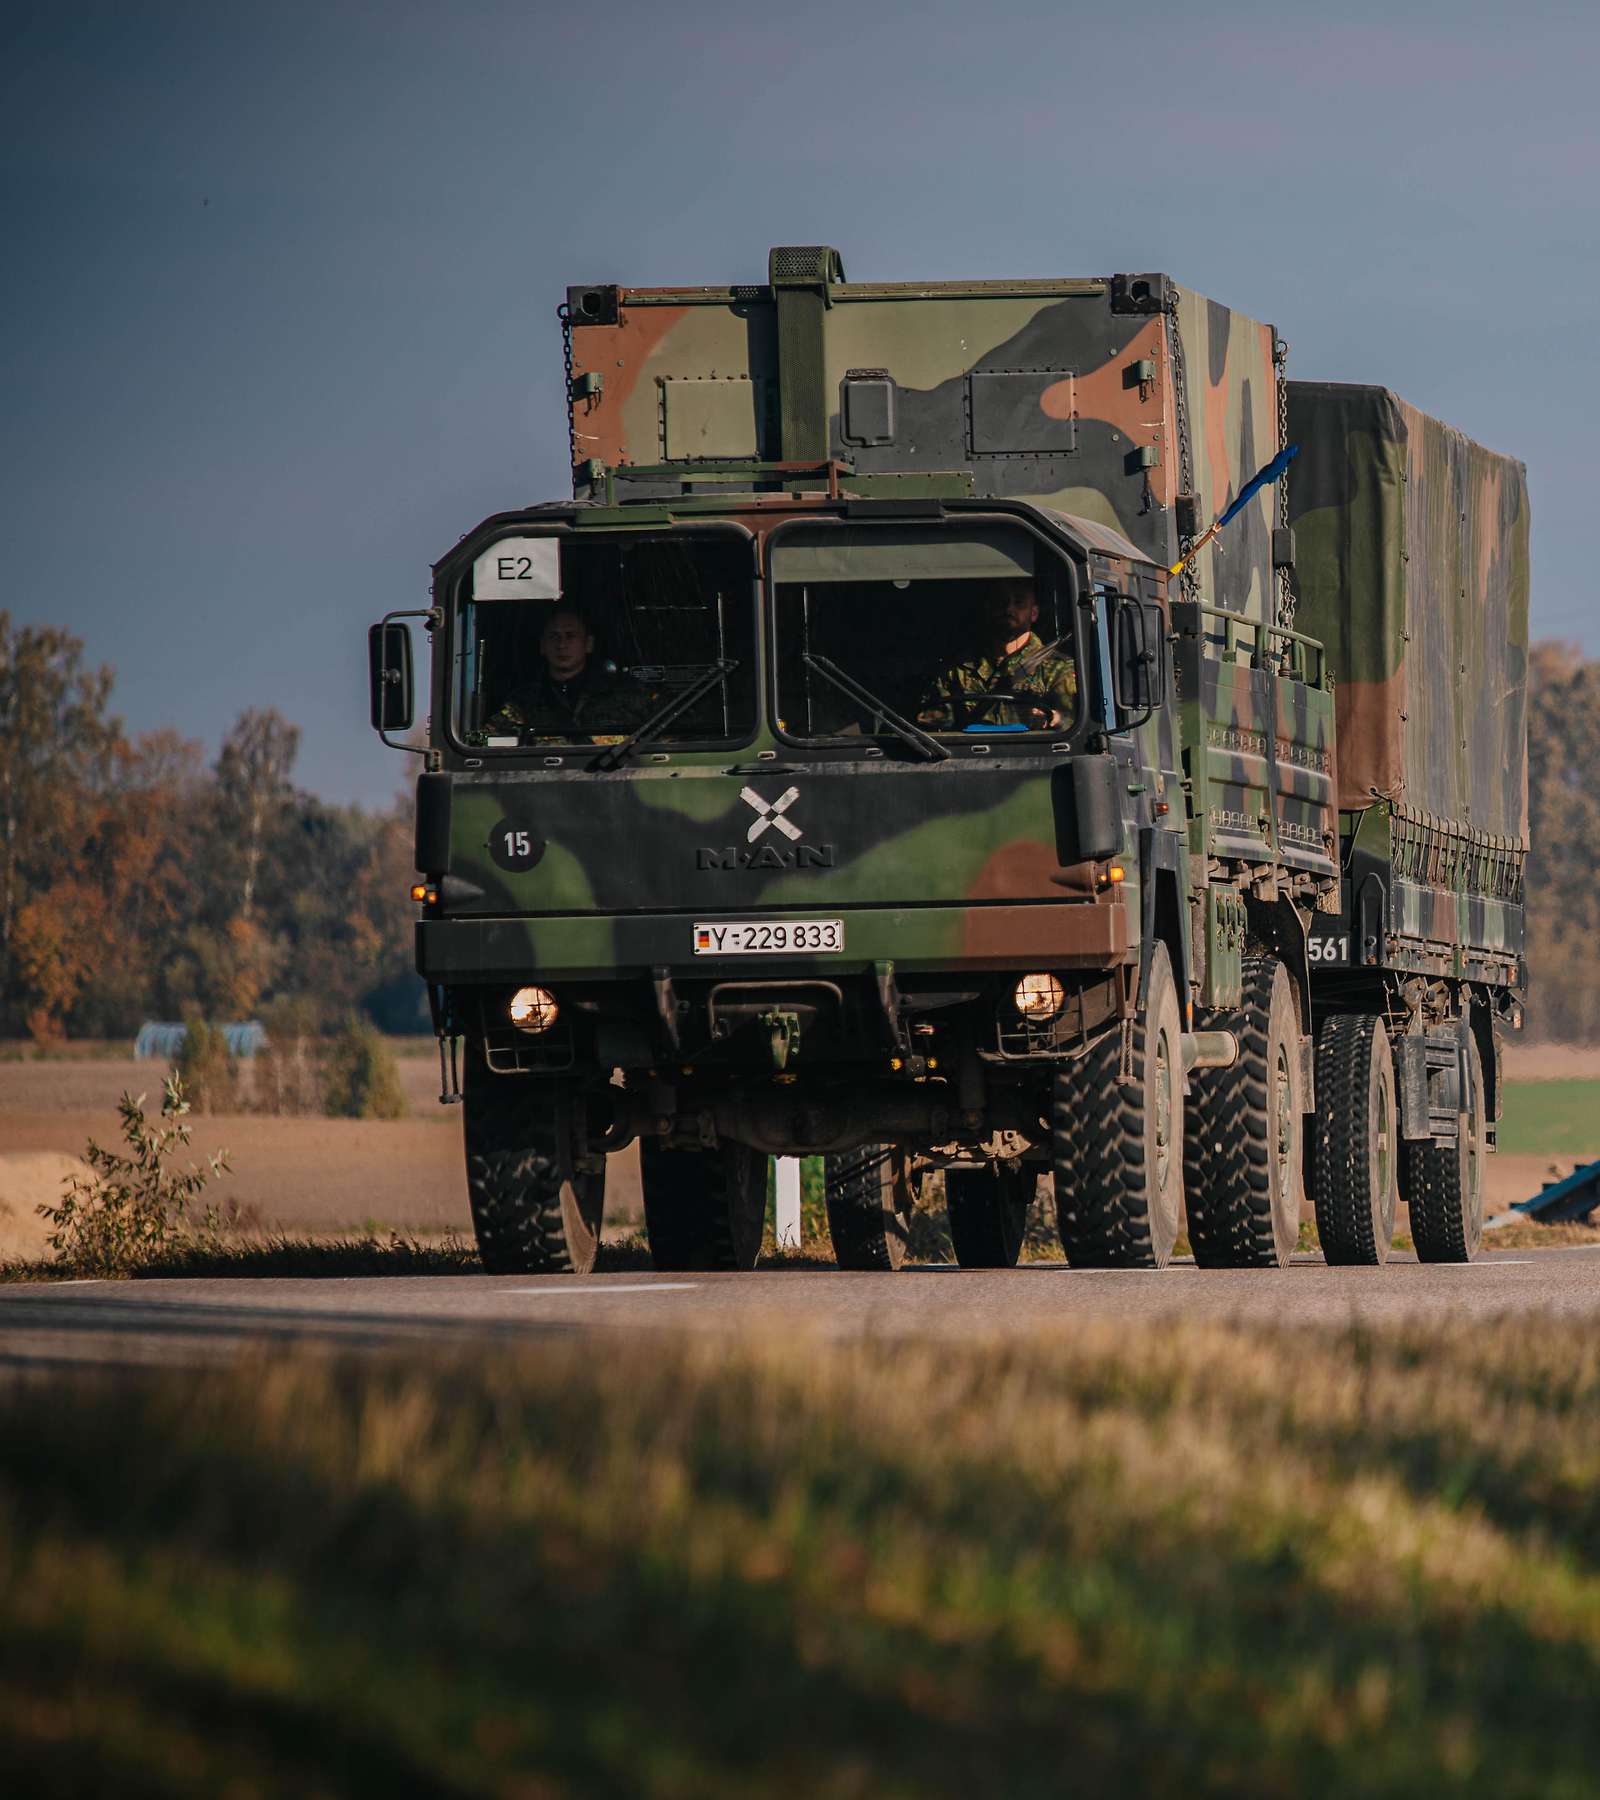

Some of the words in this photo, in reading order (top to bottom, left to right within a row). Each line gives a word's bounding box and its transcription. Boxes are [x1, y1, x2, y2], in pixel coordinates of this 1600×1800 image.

[497, 556, 533, 580] E2
[504, 831, 531, 857] 15
[793, 925, 836, 949] 833
[1308, 937, 1347, 961] 561
